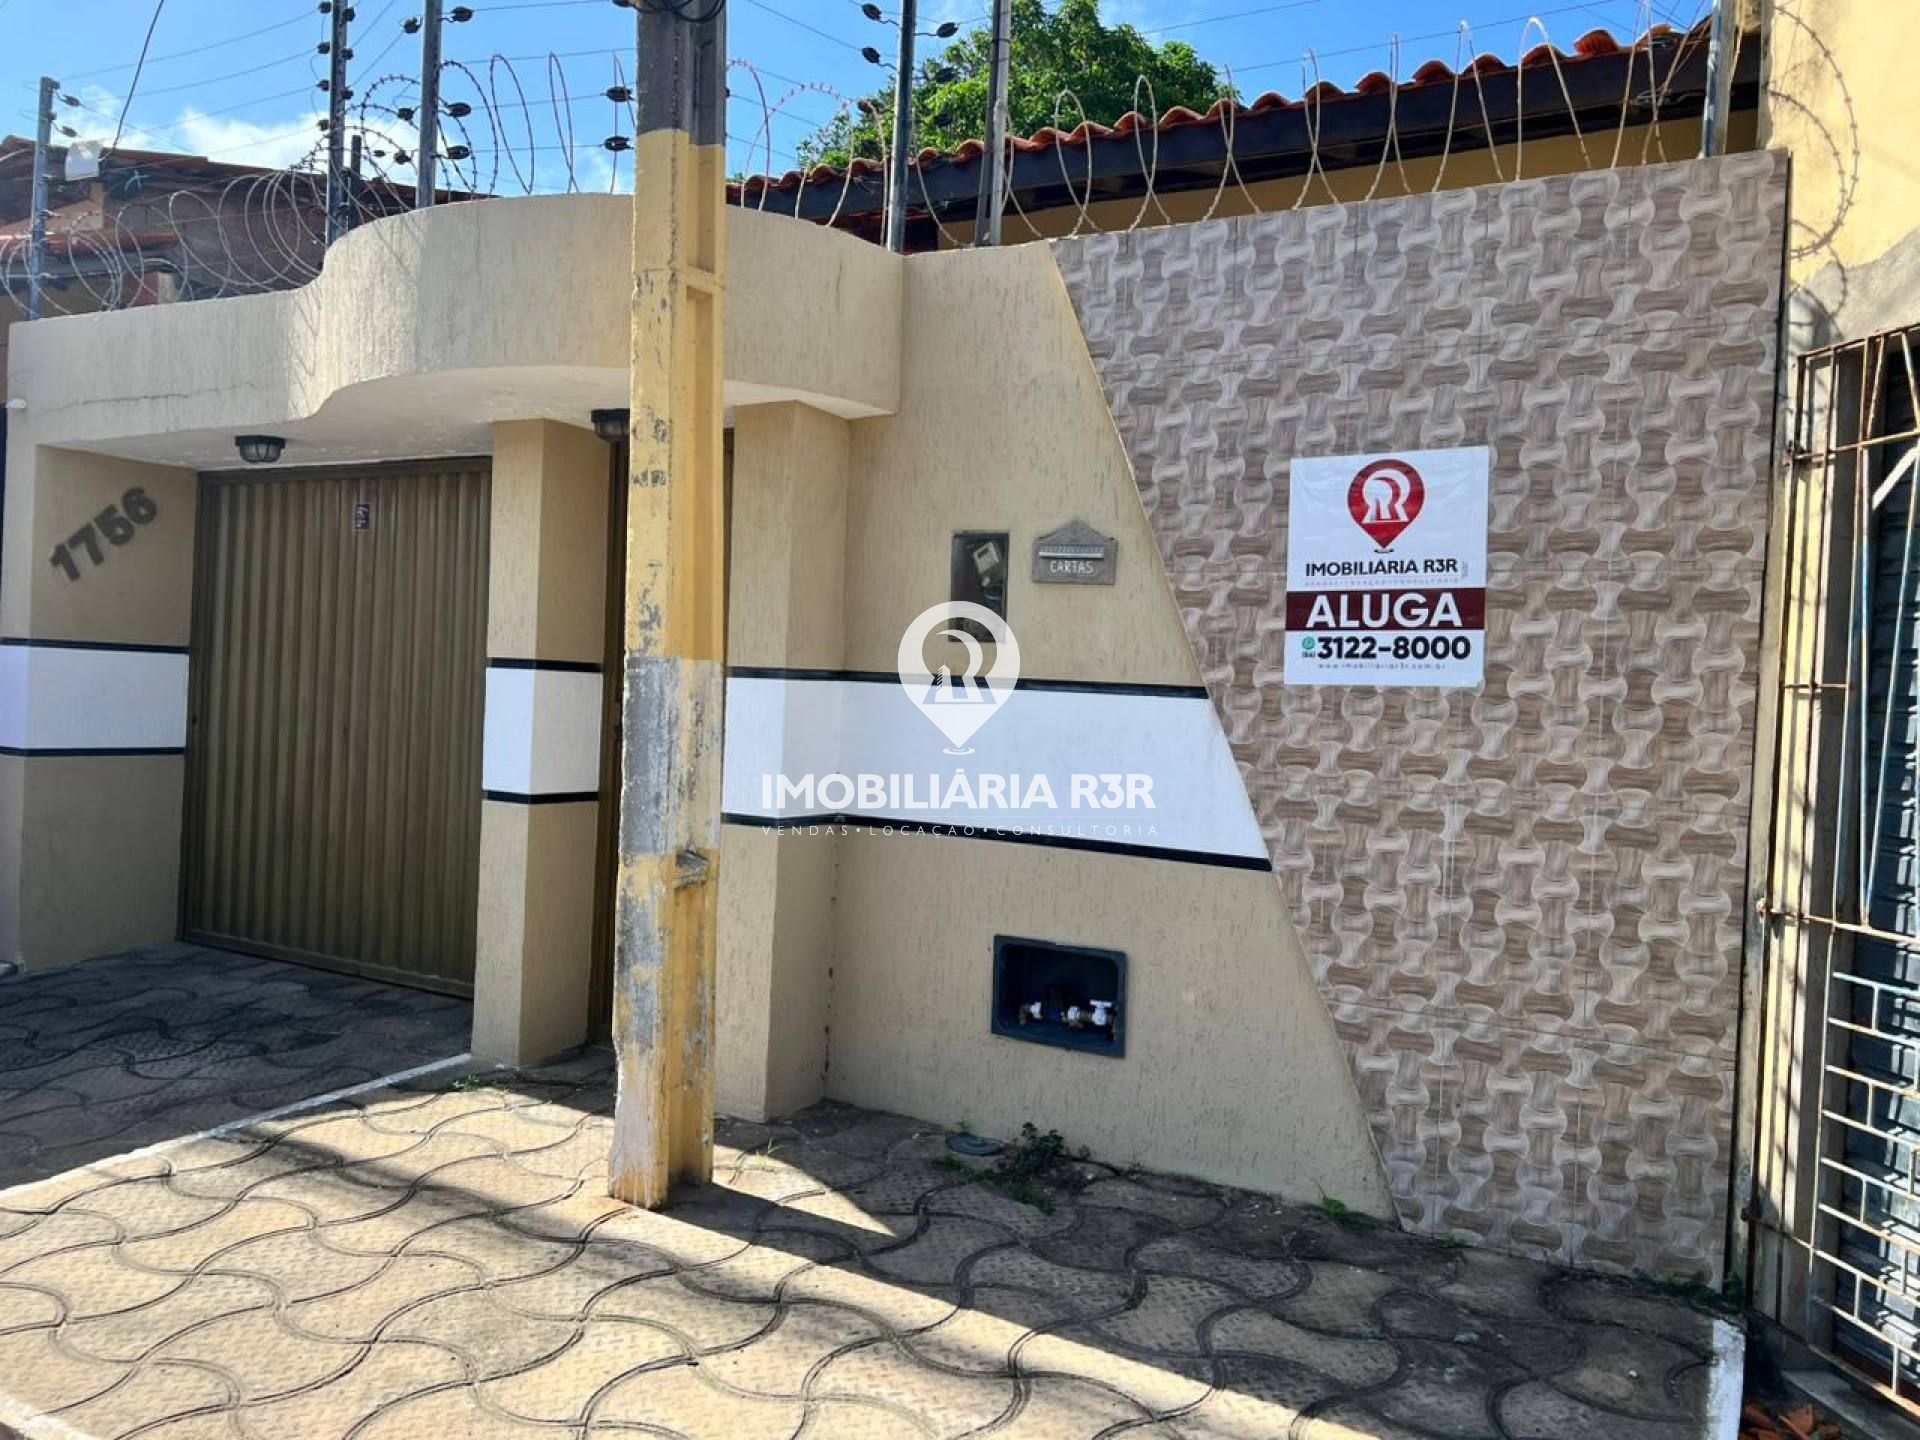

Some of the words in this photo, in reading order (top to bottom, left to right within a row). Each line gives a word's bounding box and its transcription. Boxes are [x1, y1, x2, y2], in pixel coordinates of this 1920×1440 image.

[49, 486, 157, 581] 1756
[1050, 560, 1095, 574] CARTAS
[1423, 558, 1458, 574] R3R
[1305, 592, 1463, 629] ALUGA
[1317, 635, 1471, 660] 3122-8000
